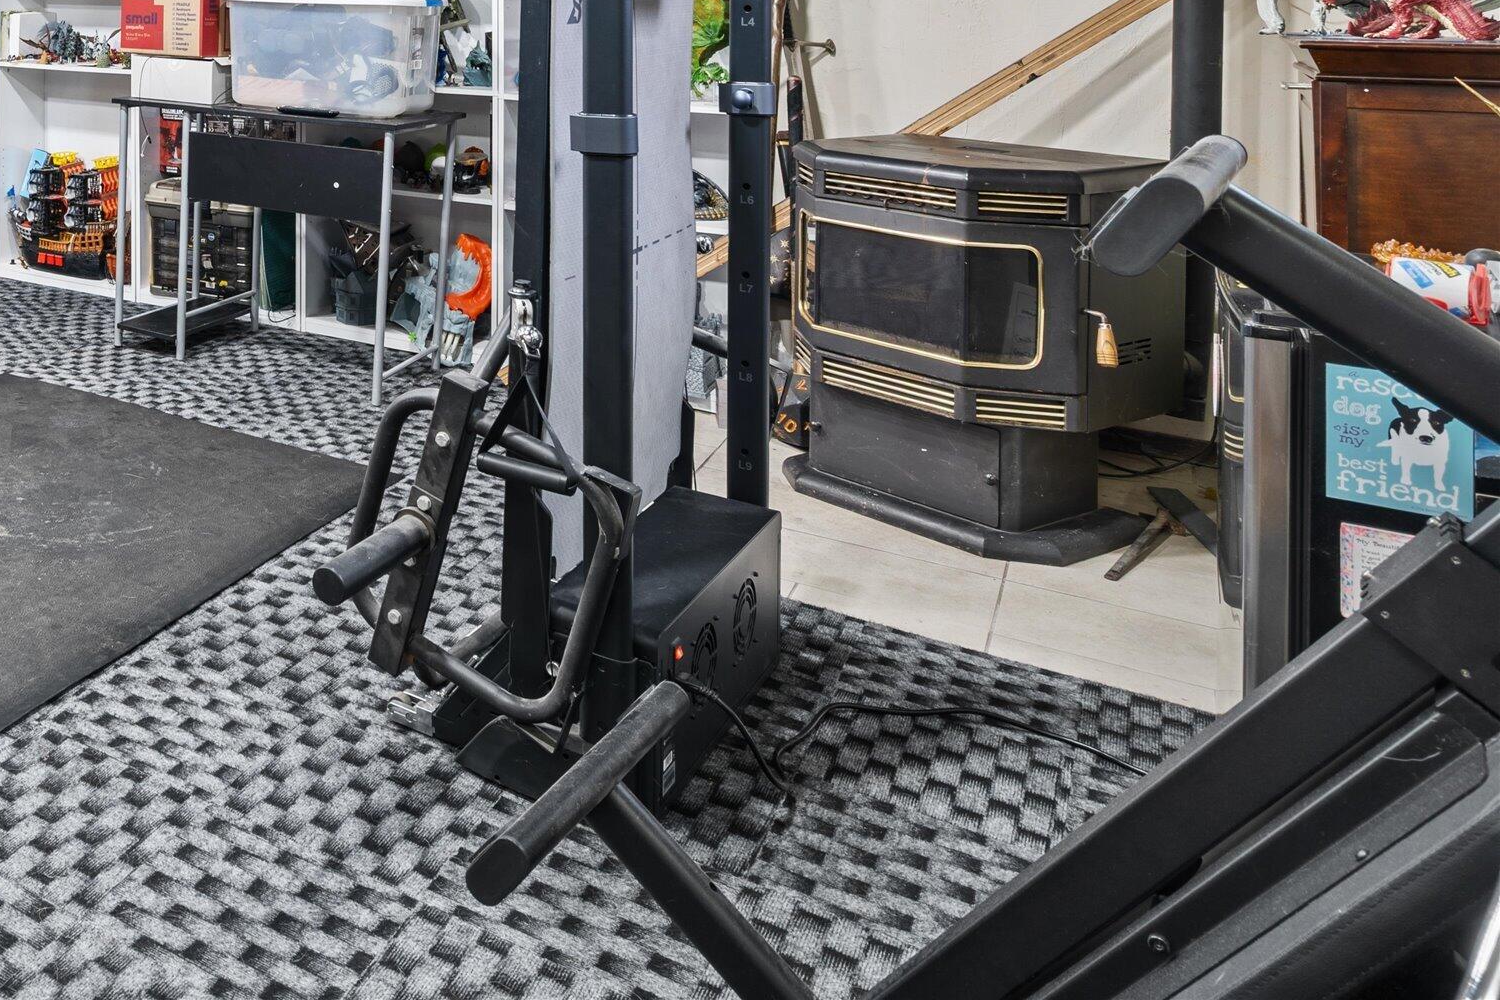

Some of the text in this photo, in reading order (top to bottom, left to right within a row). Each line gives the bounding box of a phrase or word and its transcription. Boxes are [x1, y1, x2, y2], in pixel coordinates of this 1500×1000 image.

[125, 12, 158, 25] small
[741, 16, 756, 27] L4
[740, 194, 755, 205] L6
[739, 283, 754, 294] L7
[739, 371, 754, 382] L8
[1336, 375, 1428, 400] resc
[1332, 396, 1382, 426] dog
[1342, 422, 1361, 436] is
[1339, 433, 1365, 448] my
[738, 459, 753, 471] L9
[1337, 452, 1388, 475] best
[1336, 470, 1460, 512] friend
